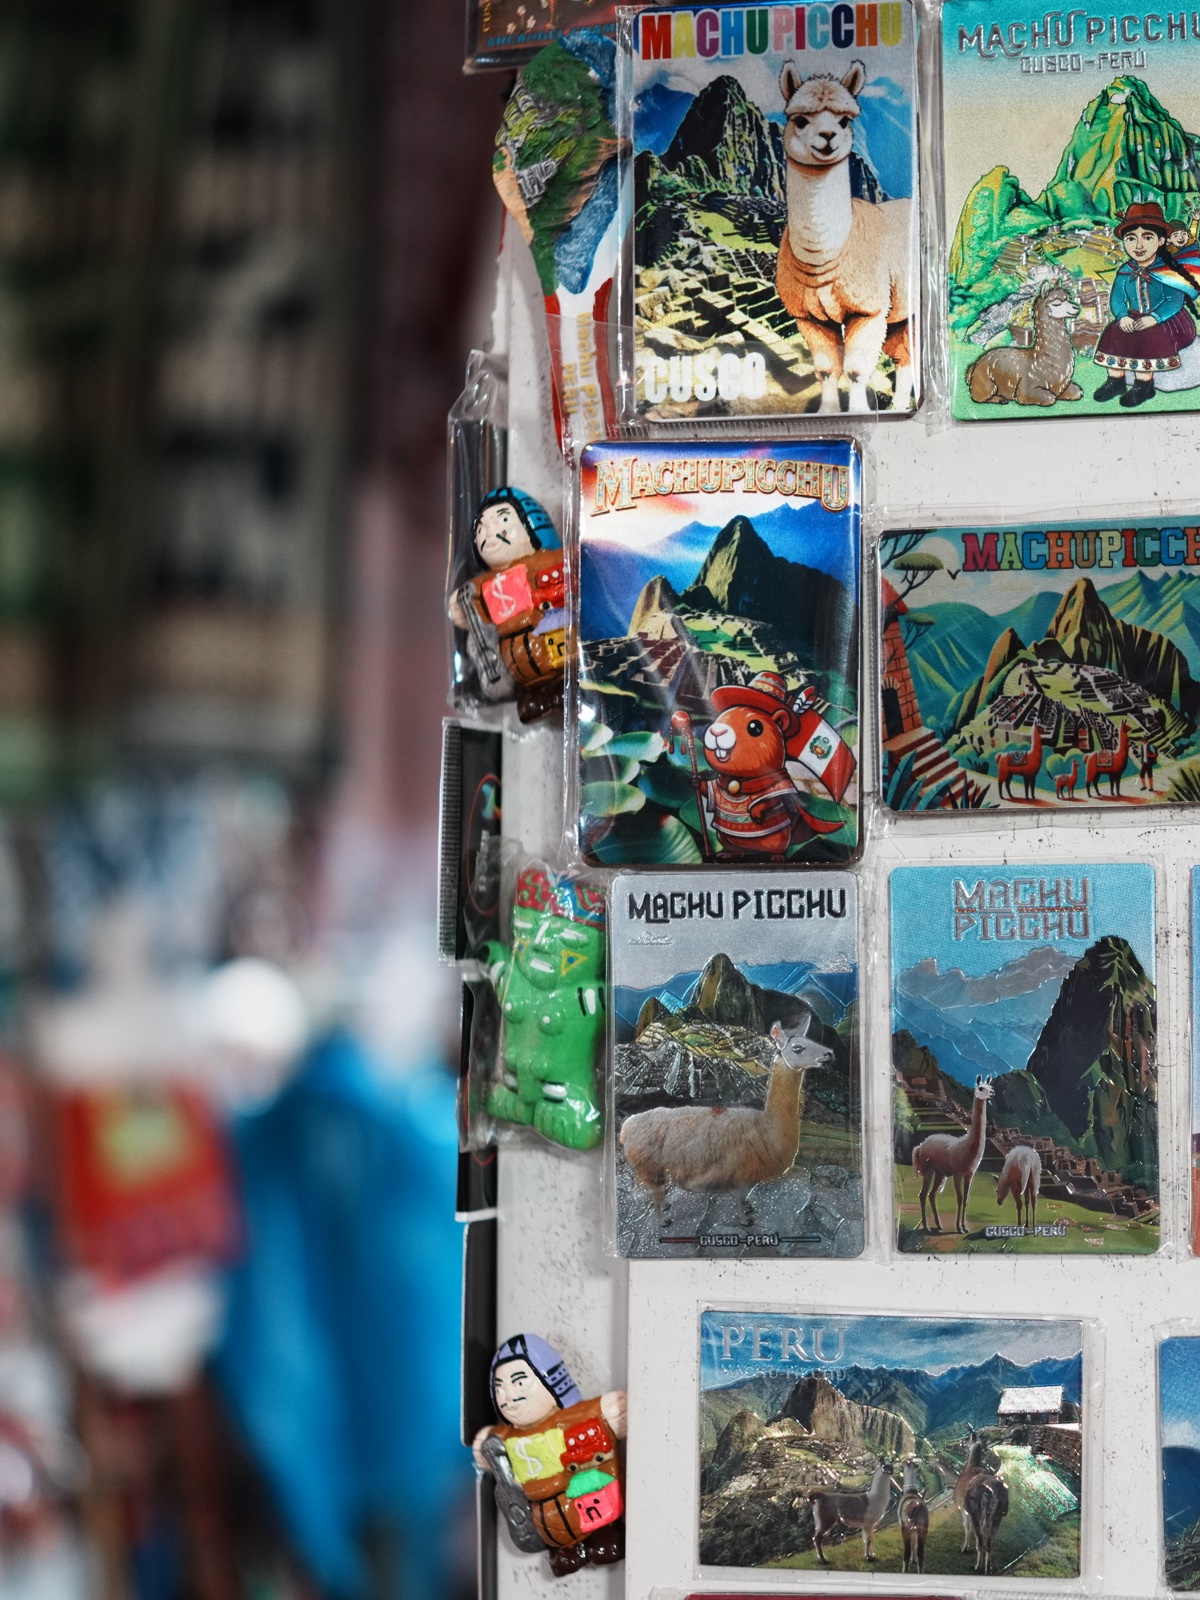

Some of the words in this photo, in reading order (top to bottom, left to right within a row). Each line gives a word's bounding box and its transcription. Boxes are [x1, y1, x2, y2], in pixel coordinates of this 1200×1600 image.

[640, 3, 904, 61] MACHUPICCHU
[958, 10, 1087, 59] MACHU
[577, 312, 597, 378] Machu
[562, 363, 579, 414] PERU
[644, 351, 765, 403] CUSCO
[591, 457, 850, 516] MACHUPICCHU
[719, 1324, 848, 1362] PERU
